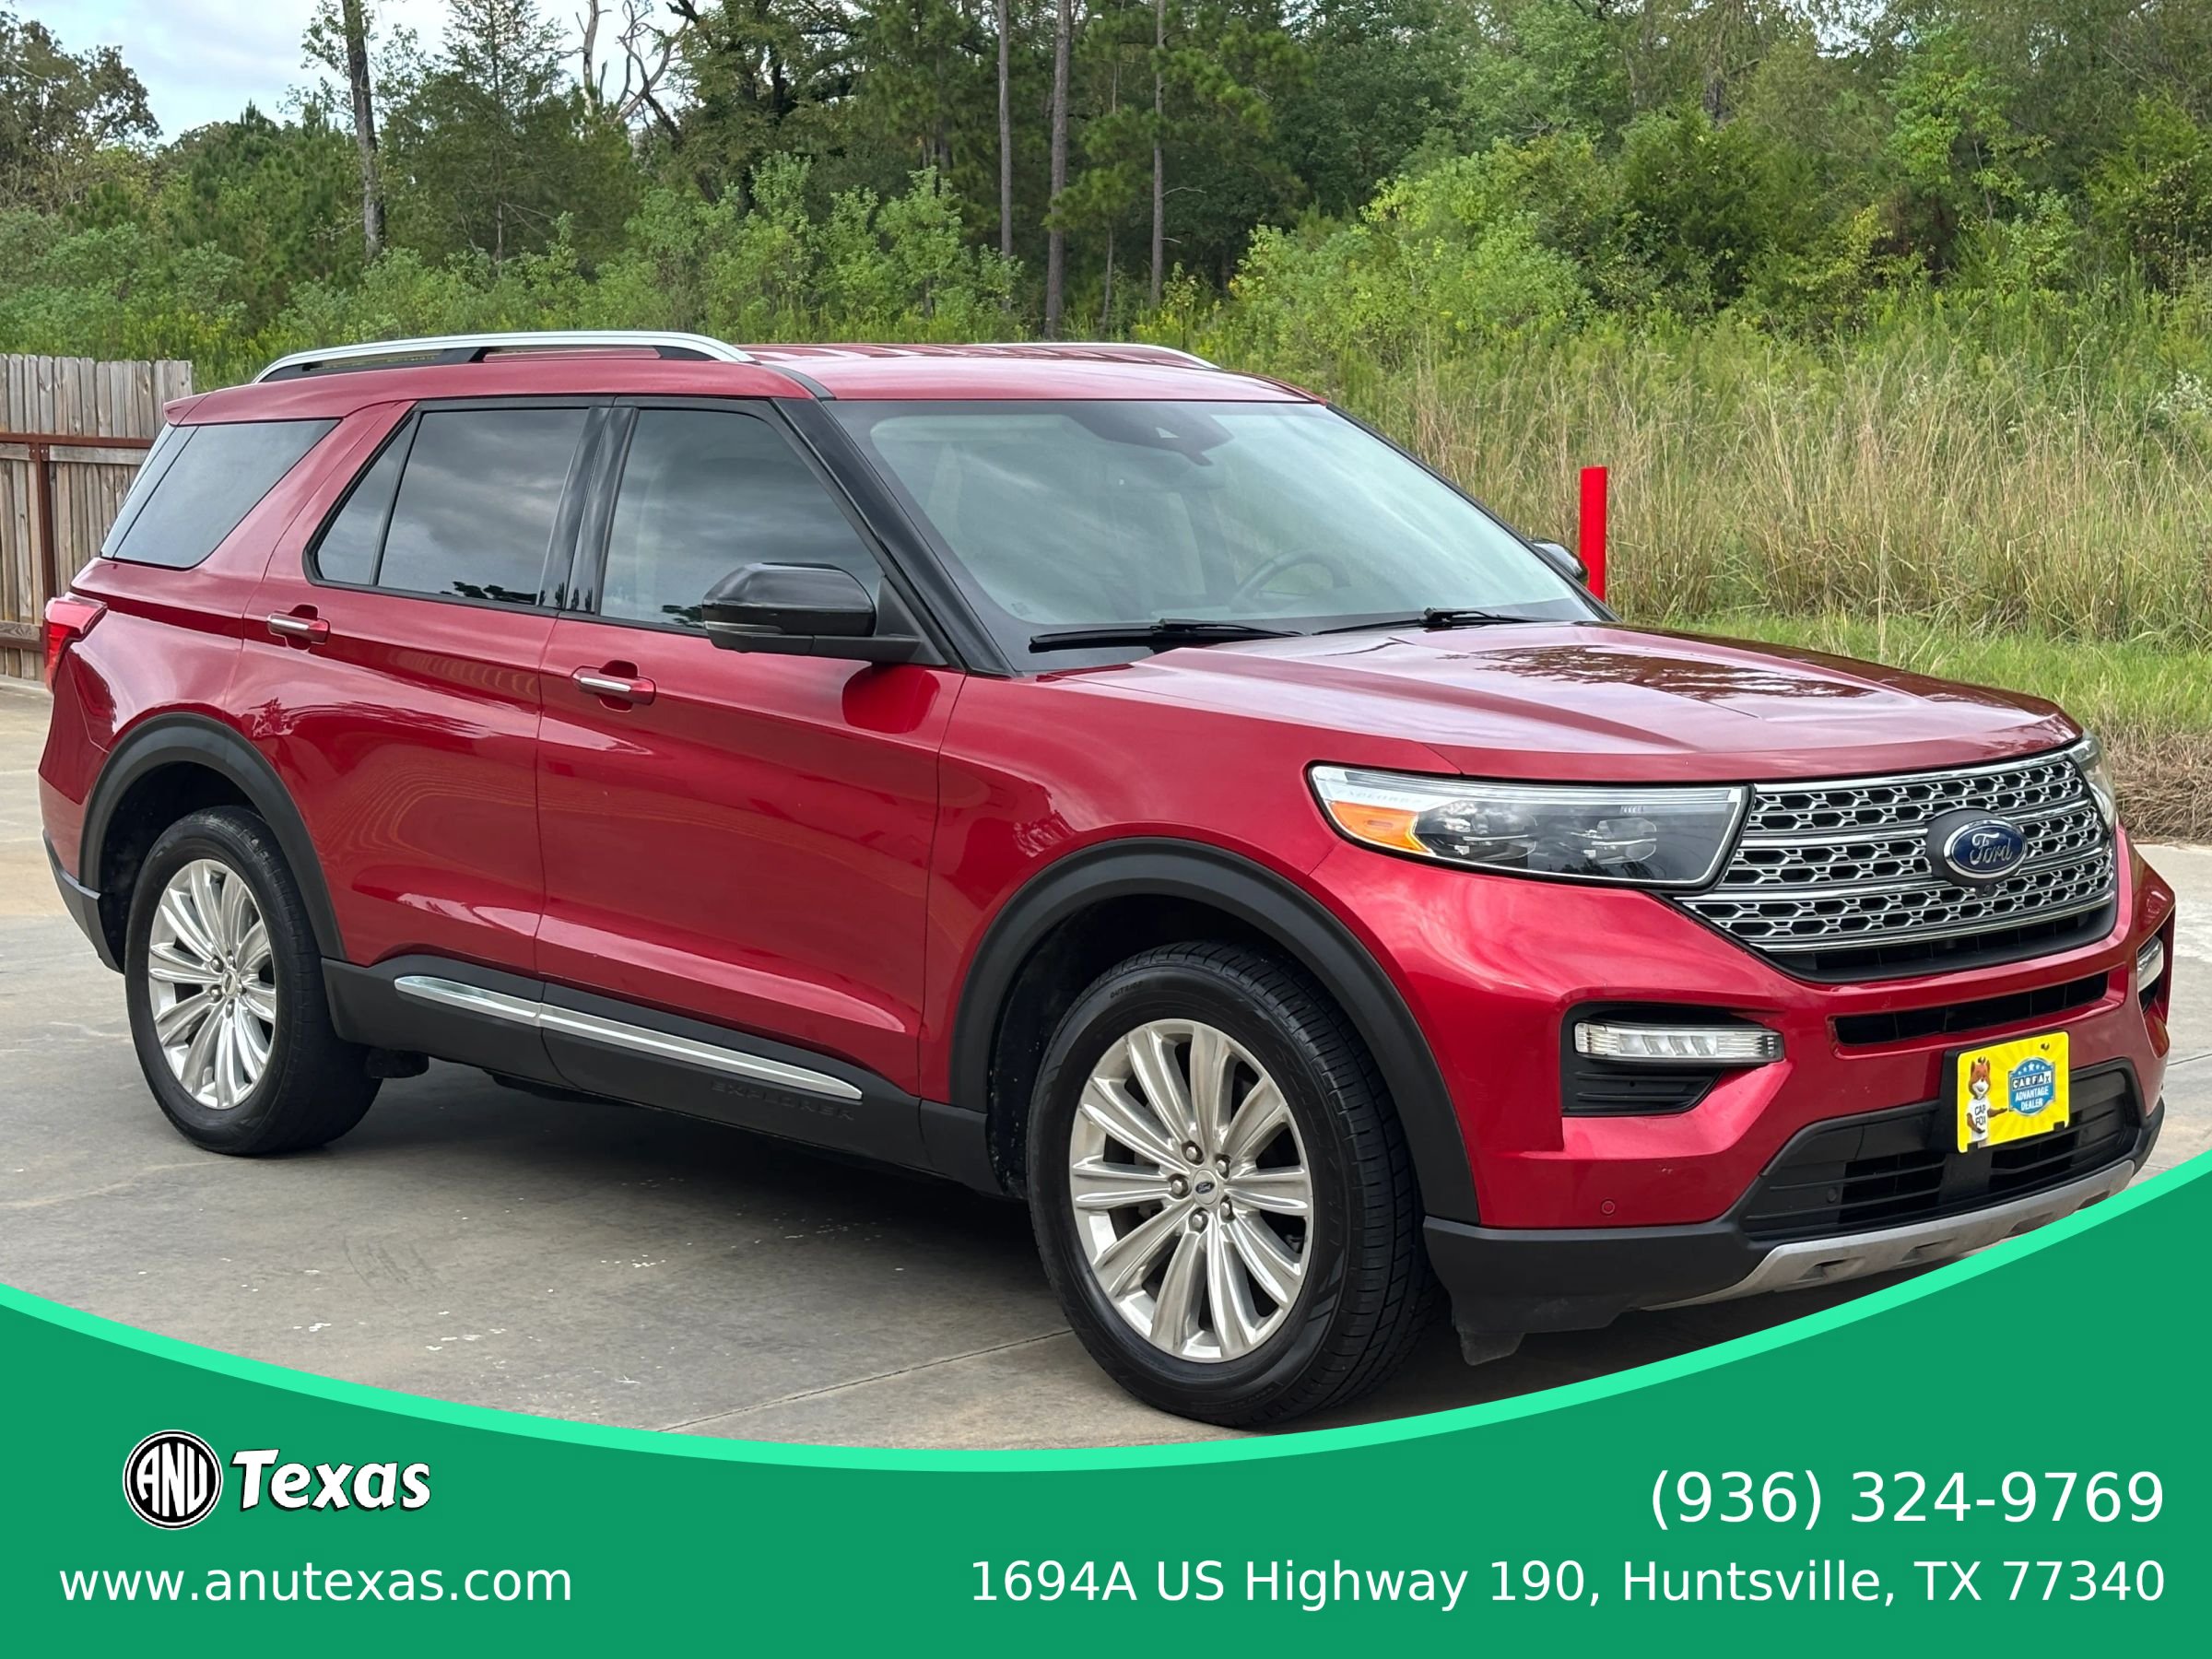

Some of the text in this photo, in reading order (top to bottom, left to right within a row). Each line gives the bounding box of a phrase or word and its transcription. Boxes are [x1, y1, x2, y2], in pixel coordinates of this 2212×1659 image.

[1970, 832, 2013, 865] Ford
[2012, 1071, 2052, 1089] CARFAX
[2015, 1086, 2049, 1101] ADVANTAGE
[2020, 1098, 2043, 1112] DEALER
